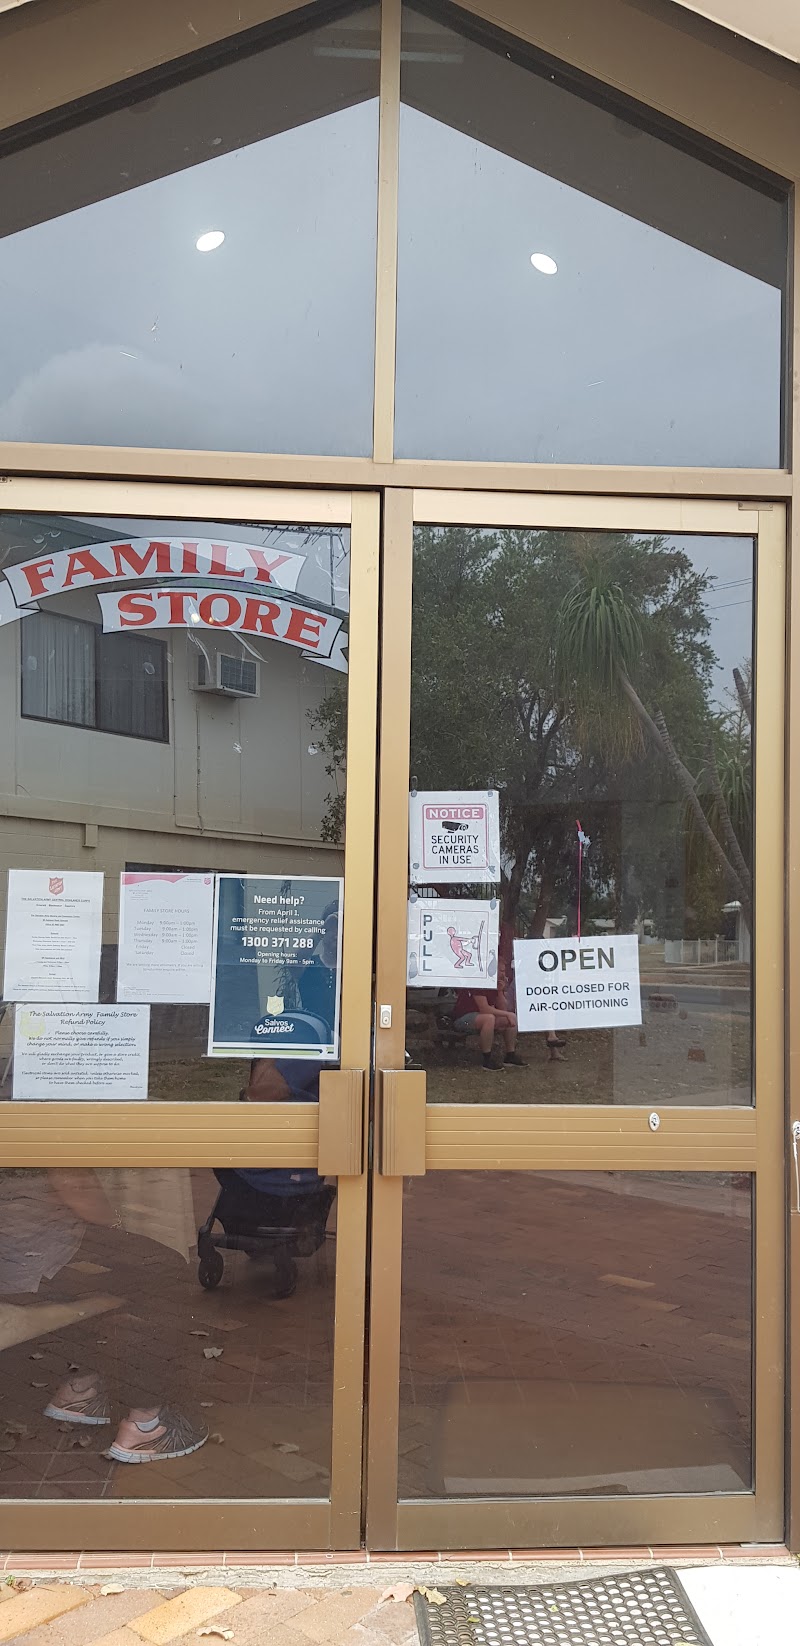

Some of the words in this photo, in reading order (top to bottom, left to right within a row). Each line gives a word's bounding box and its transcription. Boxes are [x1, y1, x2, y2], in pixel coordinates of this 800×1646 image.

[20, 542, 292, 598] FAMILY
[117, 592, 328, 648] STORE
[429, 808, 481, 819] NOTICE
[431, 835, 479, 844] SECURITY
[431, 845, 479, 855] CAMERAS
[439, 856, 449, 864] IN
[452, 856, 472, 864] USE
[254, 895, 277, 904] Need
[280, 896, 304, 906] help?
[276, 909, 292, 917] April
[241, 937, 268, 947] 1300
[271, 938, 290, 948] 371
[292, 938, 314, 948] 288
[423, 915, 433, 971] PULL
[538, 947, 614, 972] OPEN
[526, 986, 559, 996] DOOR
[562, 983, 605, 994] CLOSED
[608, 982, 630, 992] FOR
[529, 998, 629, 1012] AIR-CONDITIONING
[255, 1023, 294, 1034] Connect
